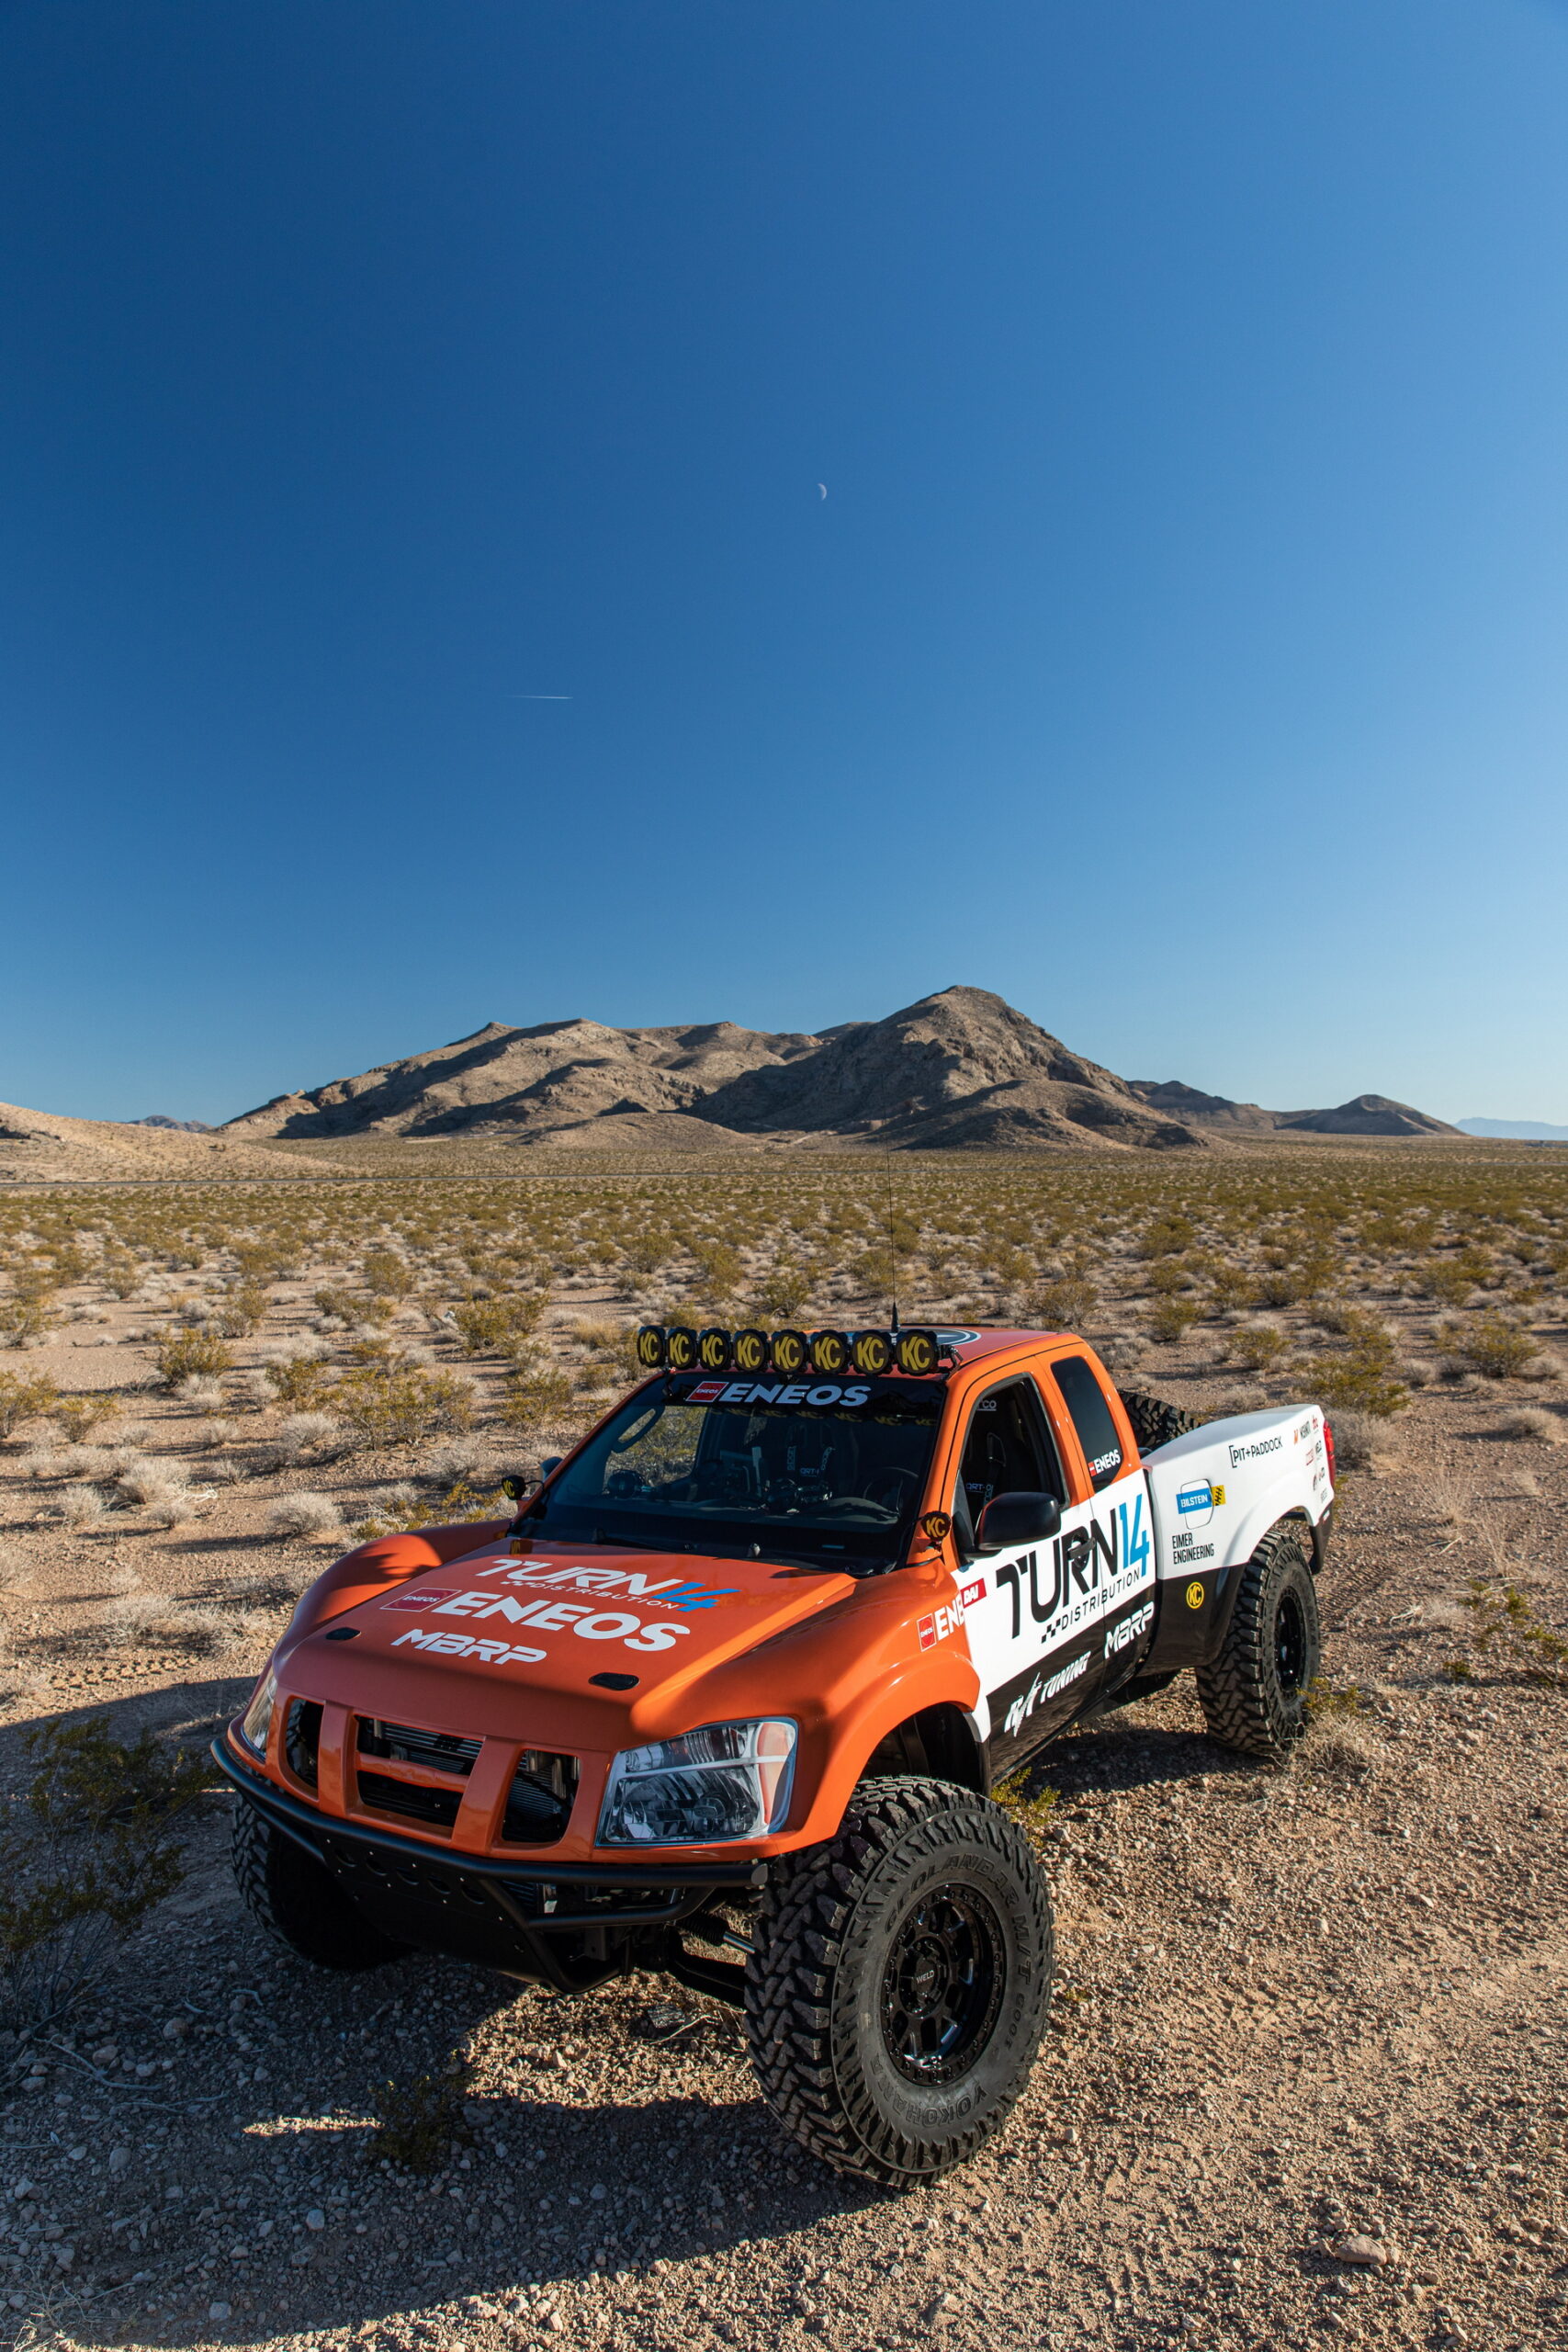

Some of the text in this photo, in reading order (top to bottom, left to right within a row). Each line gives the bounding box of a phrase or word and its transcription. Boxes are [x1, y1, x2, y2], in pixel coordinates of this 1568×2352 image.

[640, 1332, 658, 1362] KC
[670, 1333, 689, 1364] KC
[703, 1335, 723, 1366] KC
[738, 1336, 760, 1367] KC
[775, 1337, 798, 1369] KC
[815, 1337, 840, 1370] KC
[857, 1337, 884, 1370] KC
[901, 1337, 930, 1370] KC
[719, 1384, 871, 1407] ENEOS
[1094, 1449, 1121, 1474] ENEOS
[1180, 1494, 1208, 1508] BILSTEIN
[926, 1517, 945, 1538] KC
[1172, 1532, 1193, 1549] EIMER
[1173, 1544, 1214, 1565] ENGINEERING
[530, 1582, 679, 1611] DISTRIBUTION
[1061, 1567, 1140, 1631] DISTRIBUTION
[1189, 1584, 1201, 1606] KC
[431, 1591, 691, 1651] ENEOS
[1104, 1601, 1154, 1659] MBRP
[390, 1628, 547, 1665] MBRP
[1040, 1651, 1091, 1704] TUNING
[1012, 1915, 1032, 1985] M/T
[916, 1970, 935, 1984] WELD
[870, 2053, 988, 2128] YOKOHAMA
